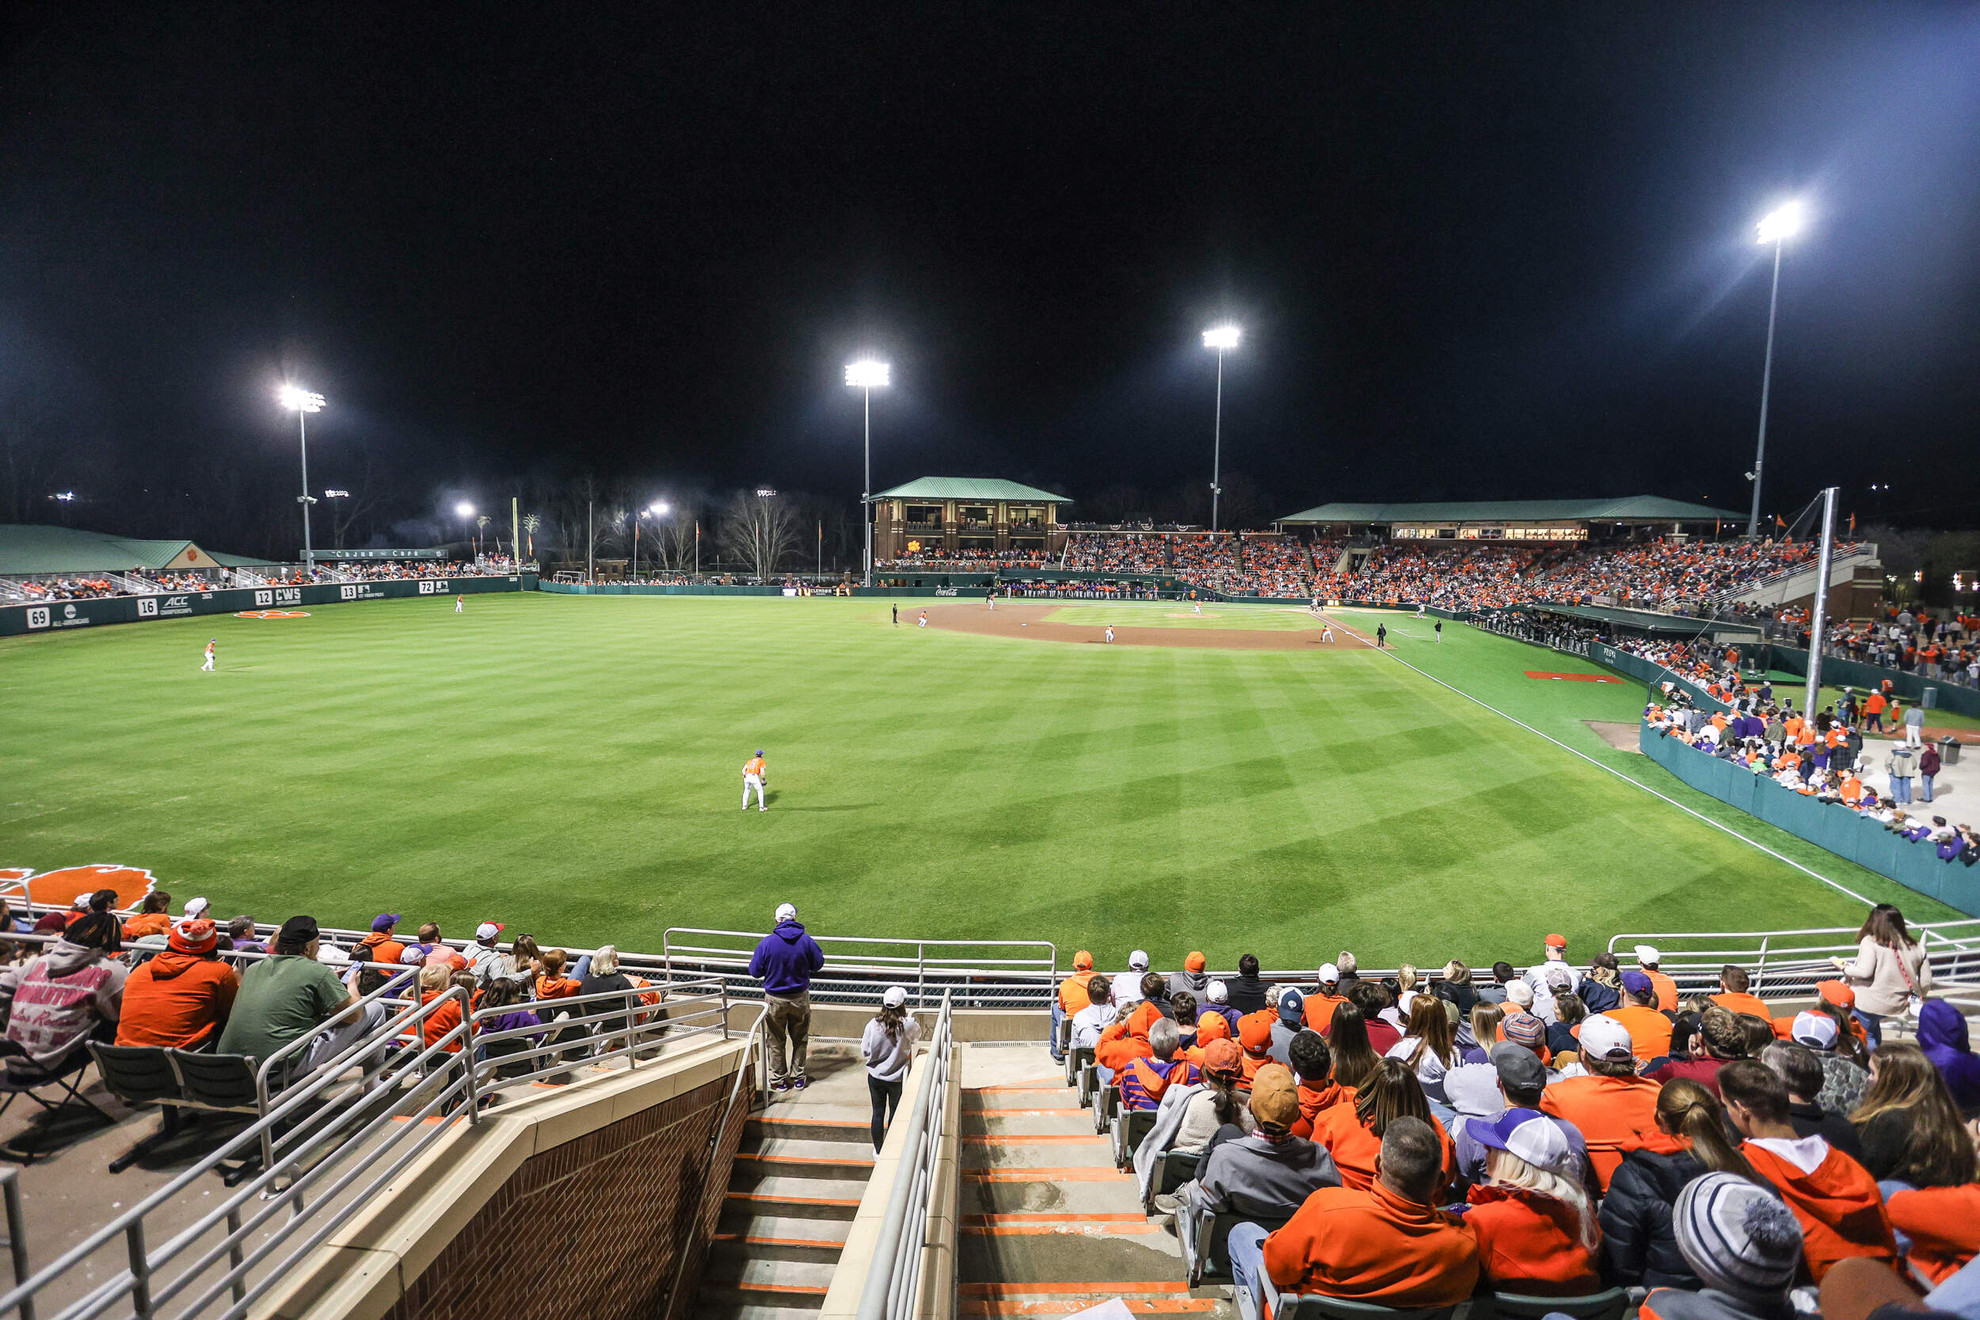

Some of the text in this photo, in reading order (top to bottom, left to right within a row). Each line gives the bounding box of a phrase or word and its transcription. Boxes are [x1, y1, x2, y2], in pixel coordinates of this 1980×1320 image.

[344, 587, 354, 597] 13
[421, 582, 432, 592] 72
[259, 593, 270, 603] 12
[275, 588, 301, 600] CWS
[164, 596, 189, 606] ACC
[141, 601, 154, 613] 16
[32, 611, 46, 625] 69
